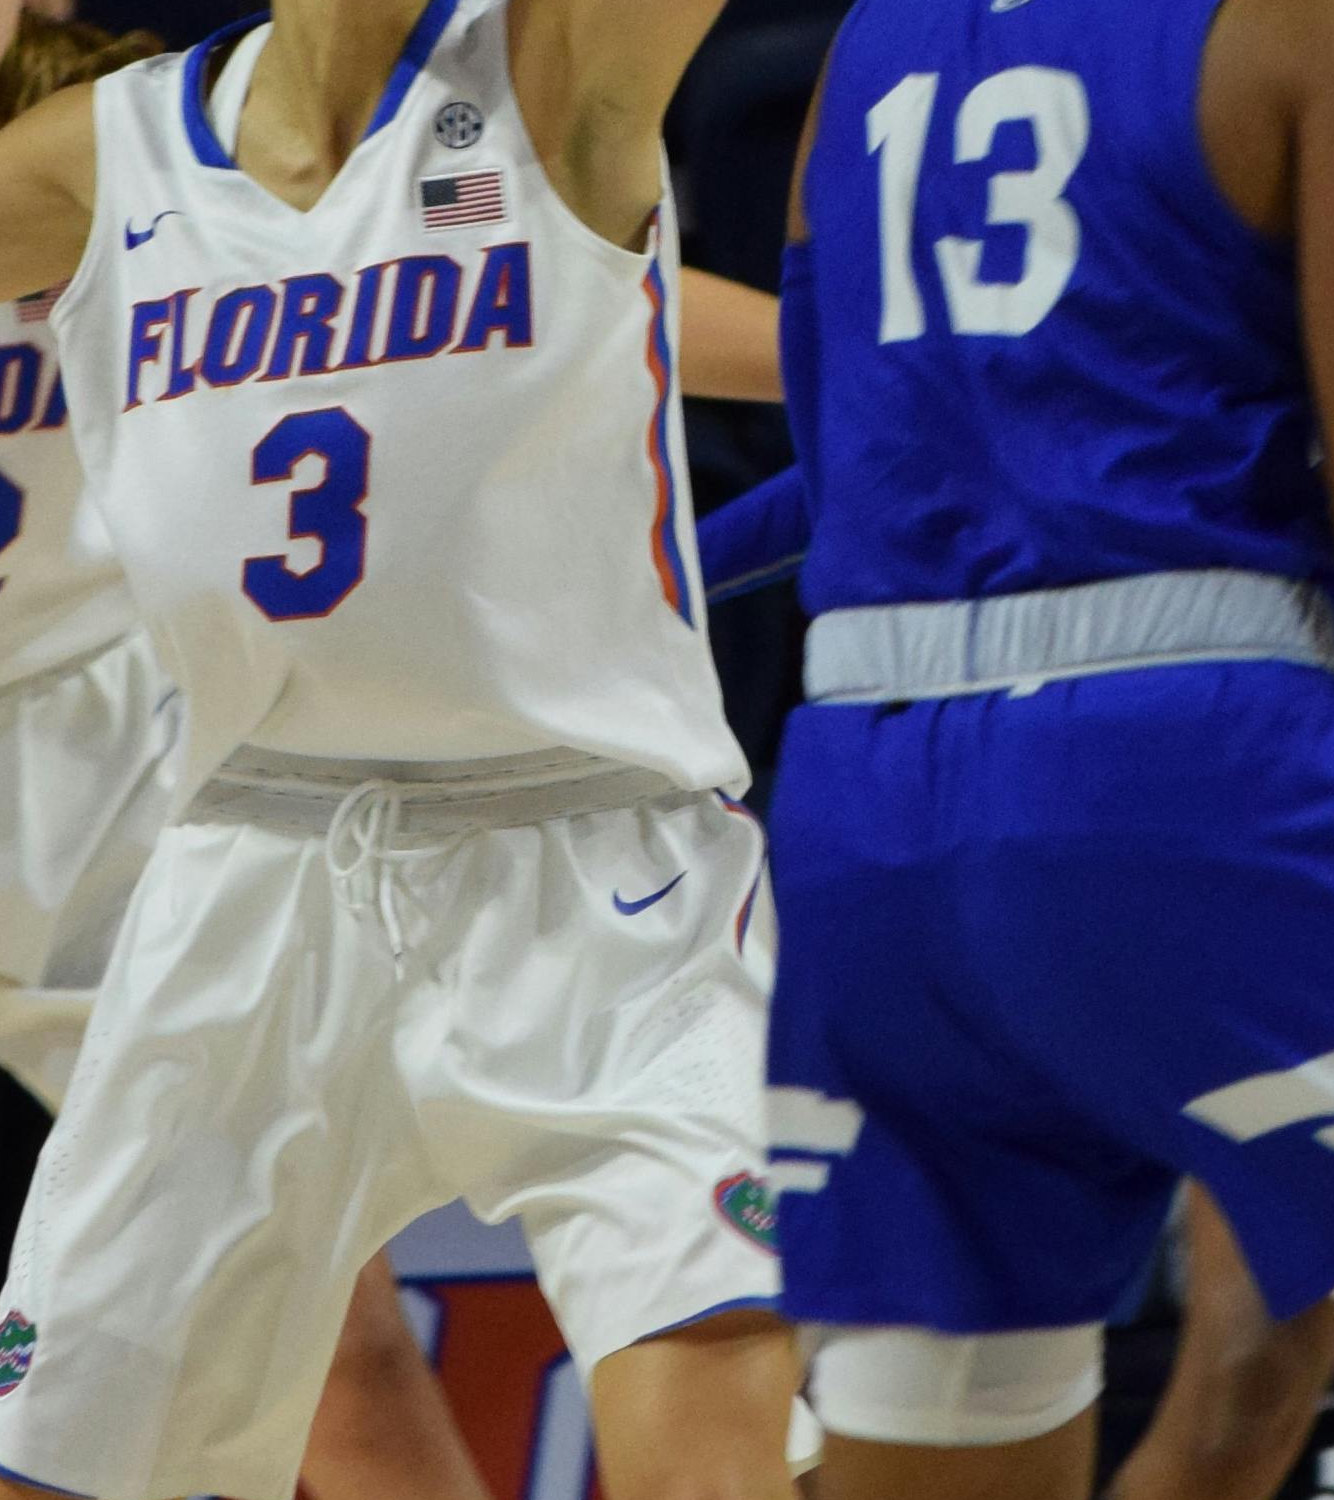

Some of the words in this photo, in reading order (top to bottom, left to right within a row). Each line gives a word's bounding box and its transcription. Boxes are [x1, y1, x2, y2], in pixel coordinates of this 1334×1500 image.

[865, 64, 1092, 346] 13
[123, 241, 533, 412] FLORIDA
[241, 405, 372, 622] 3
